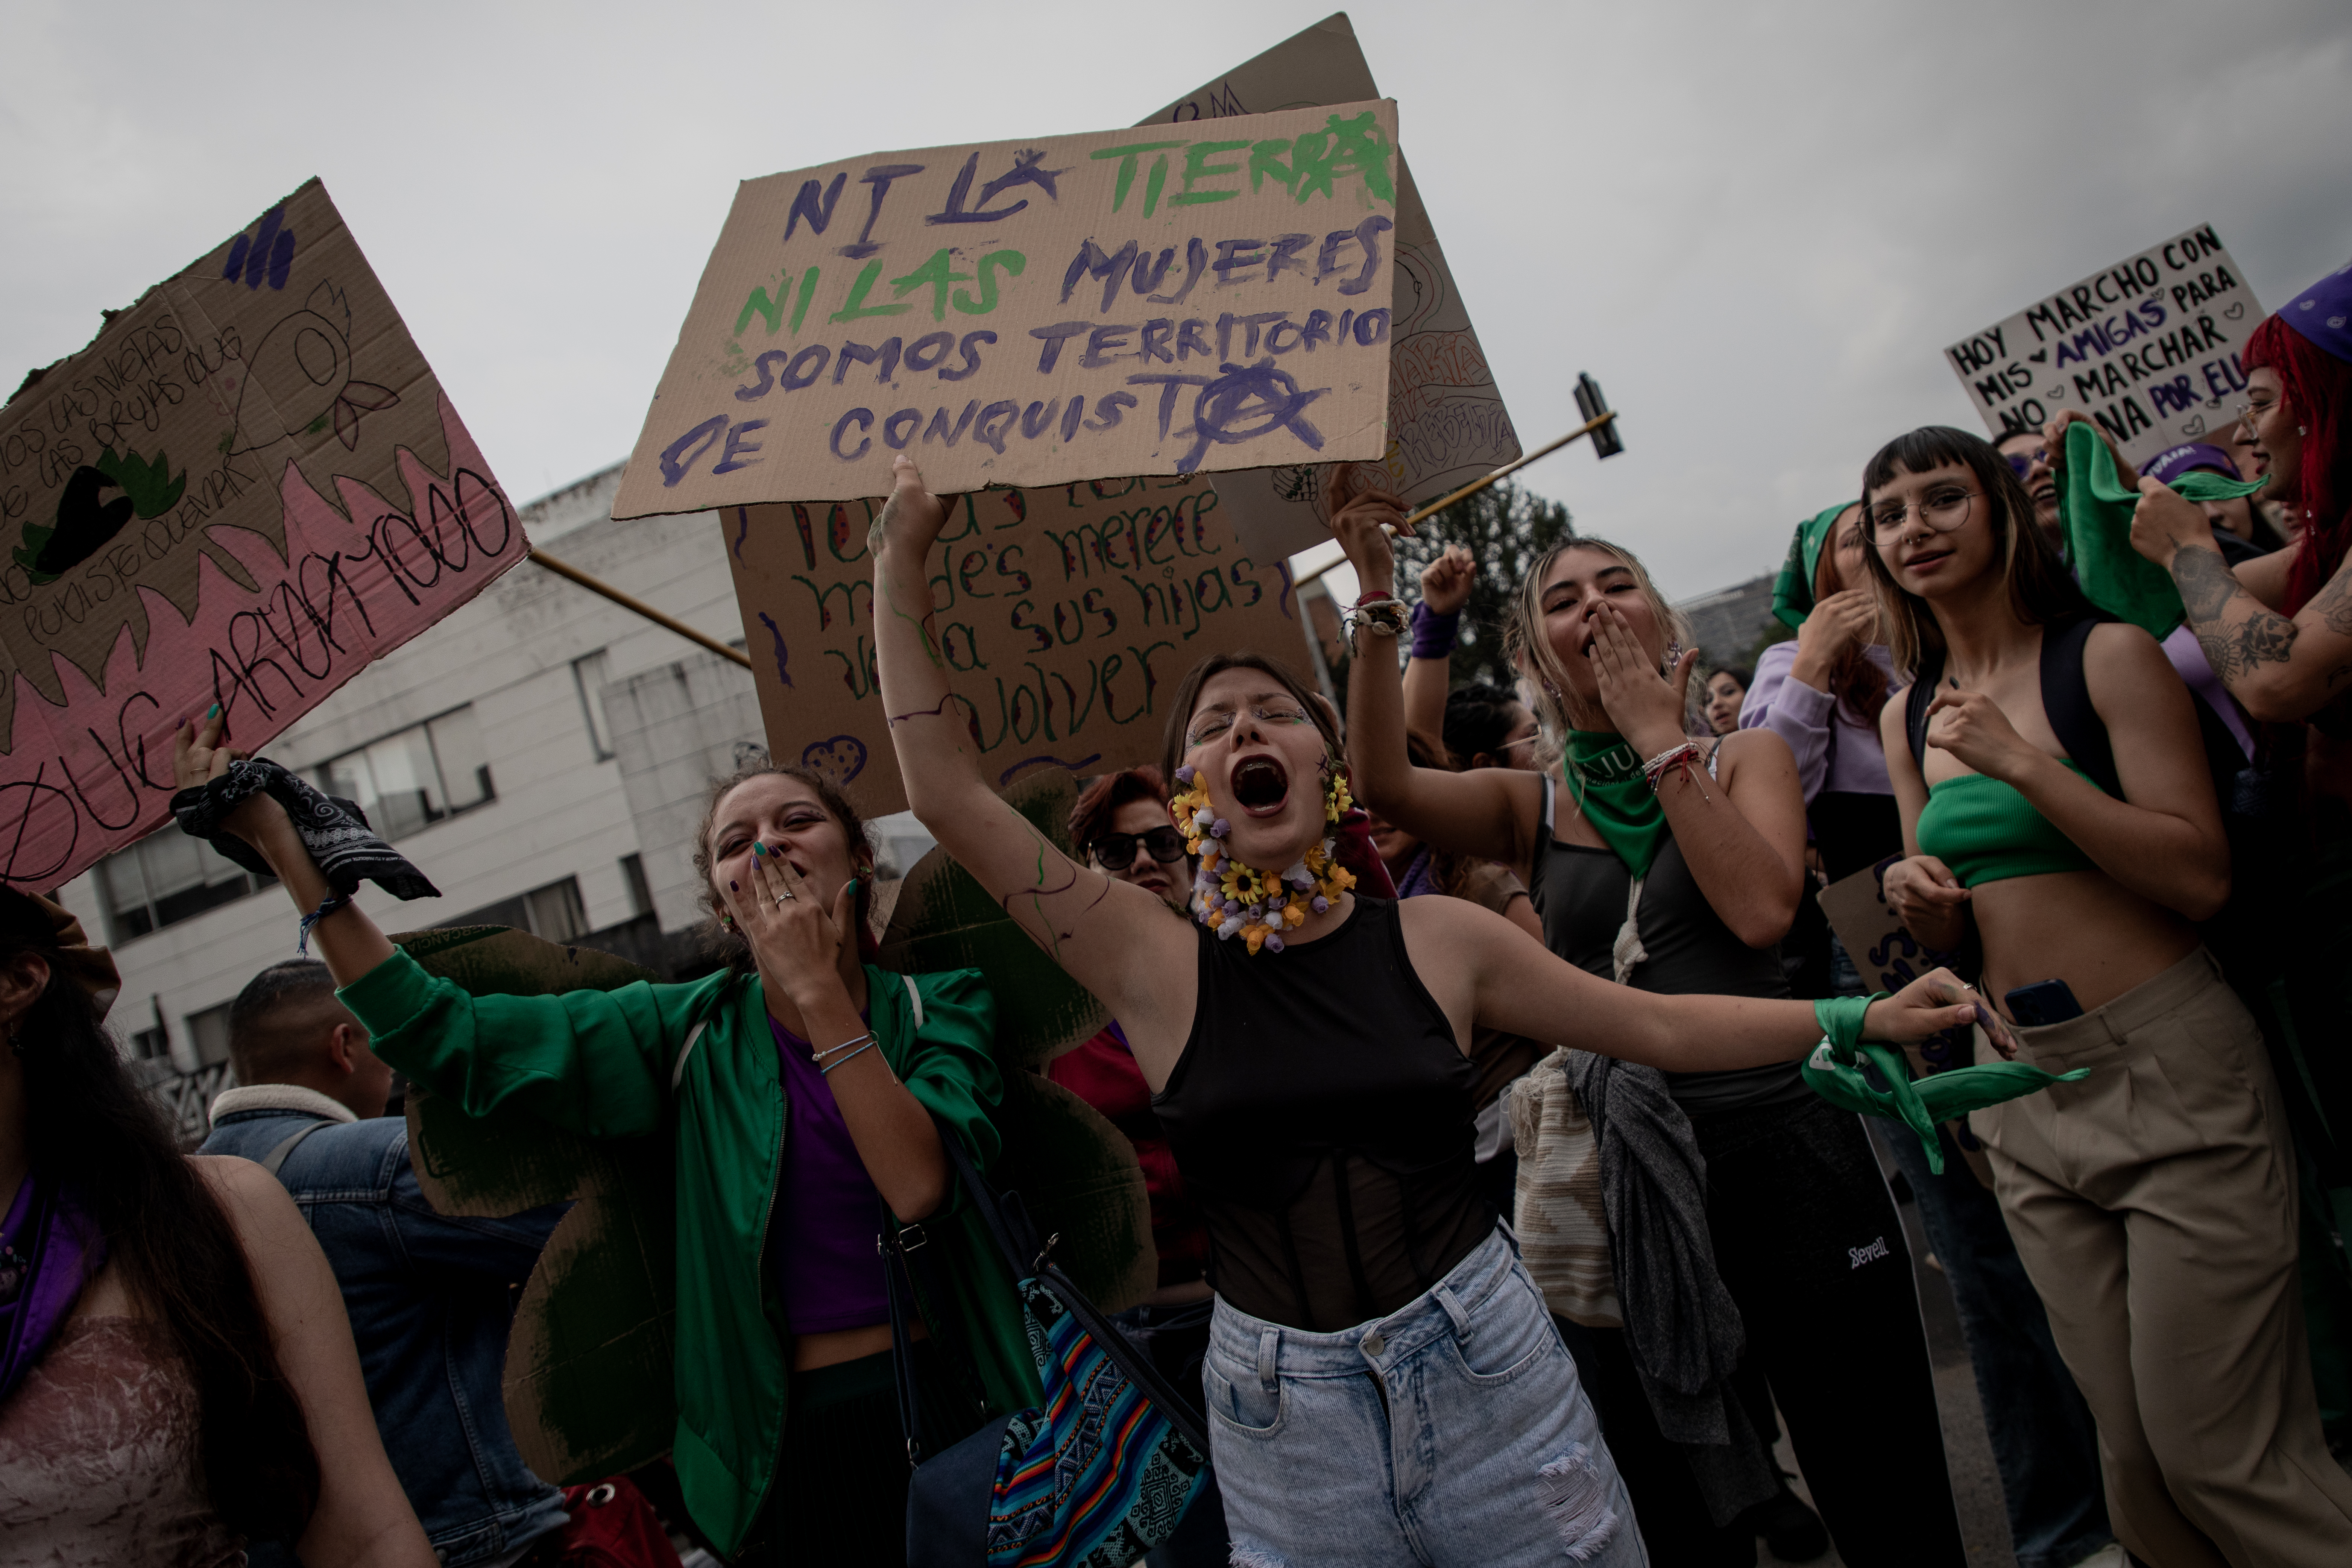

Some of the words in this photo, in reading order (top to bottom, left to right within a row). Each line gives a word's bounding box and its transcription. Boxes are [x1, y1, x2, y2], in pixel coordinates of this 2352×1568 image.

[784, 164, 925, 259] NI
[924, 148, 1075, 226] LA
[1090, 111, 1396, 219] TIERRA
[733, 266, 820, 337] NI
[828, 249, 1026, 324] LAS
[1058, 215, 1393, 313] MUJERES
[1952, 327, 2007, 375] HOY
[2027, 258, 2159, 341] MARCHO
[2163, 226, 2221, 270] CON
[1975, 362, 2032, 406] MIS
[2057, 299, 2166, 368] AMIGAS
[2172, 265, 2236, 312] PARA
[40, 439, 83, 488] LAS
[89, 374, 184, 448] BRUJAS
[184, 326, 241, 388] QUE
[49, 381, 99, 433] LAS
[95, 314, 182, 398] NIETAS
[735, 330, 997, 402] SOMOS
[1028, 308, 1391, 374] TERRITORIO
[1999, 398, 2045, 432] NO
[2073, 315, 2228, 403] MARCHAR
[2149, 374, 2203, 419] POR
[659, 413, 771, 487] DE
[830, 356, 1332, 474] CONQUISTA
[24, 544, 140, 645] PUDISTE
[140, 455, 256, 560] QUEMAR
[345, 468, 510, 606] TODO
[1011, 588, 1117, 653] sus
